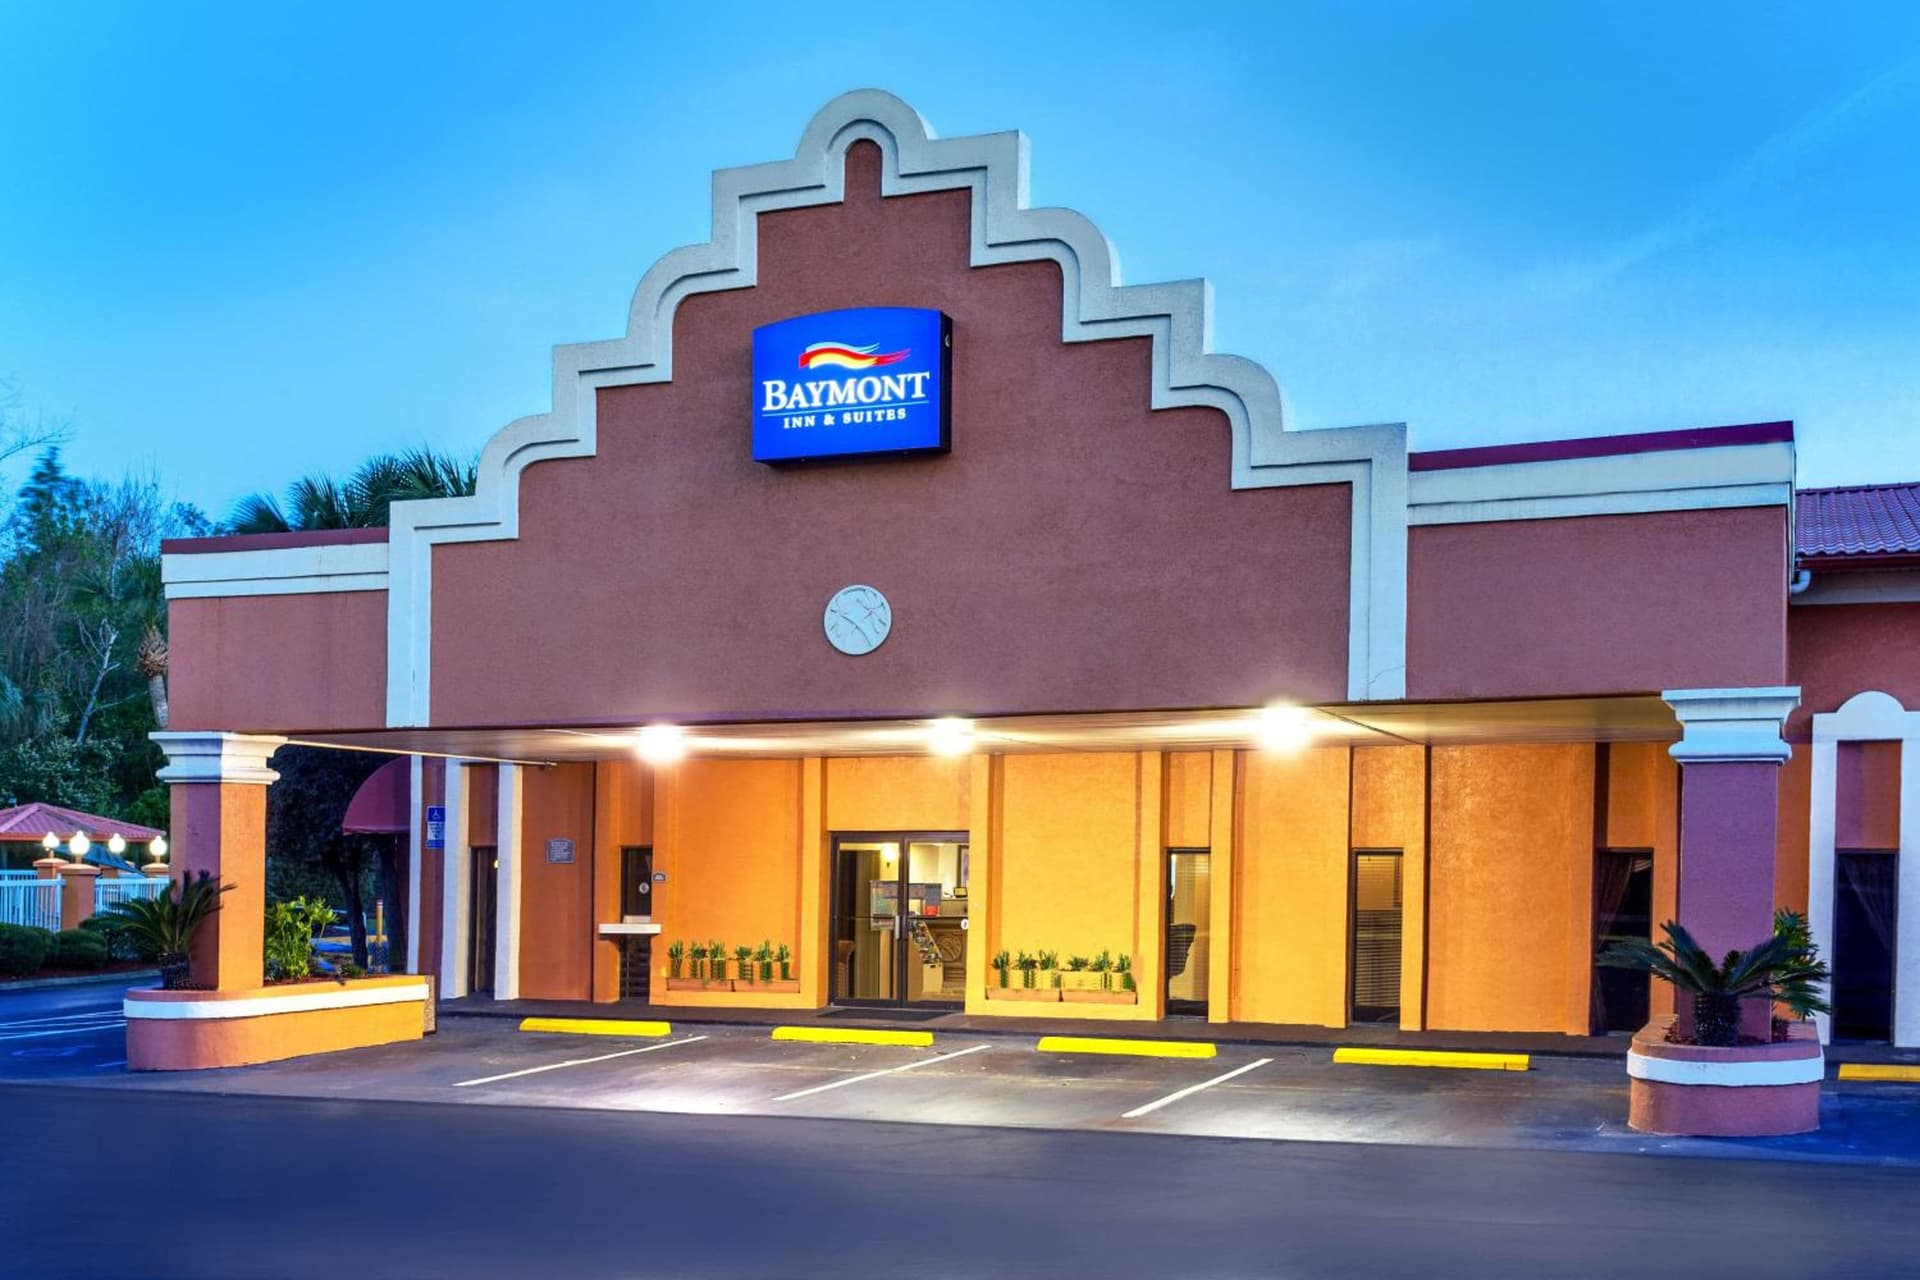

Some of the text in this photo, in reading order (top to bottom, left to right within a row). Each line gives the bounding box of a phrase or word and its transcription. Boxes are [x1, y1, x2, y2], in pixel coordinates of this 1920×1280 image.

[762, 371, 930, 411] BAYMONT
[783, 407, 907, 429] INN & SUITES
